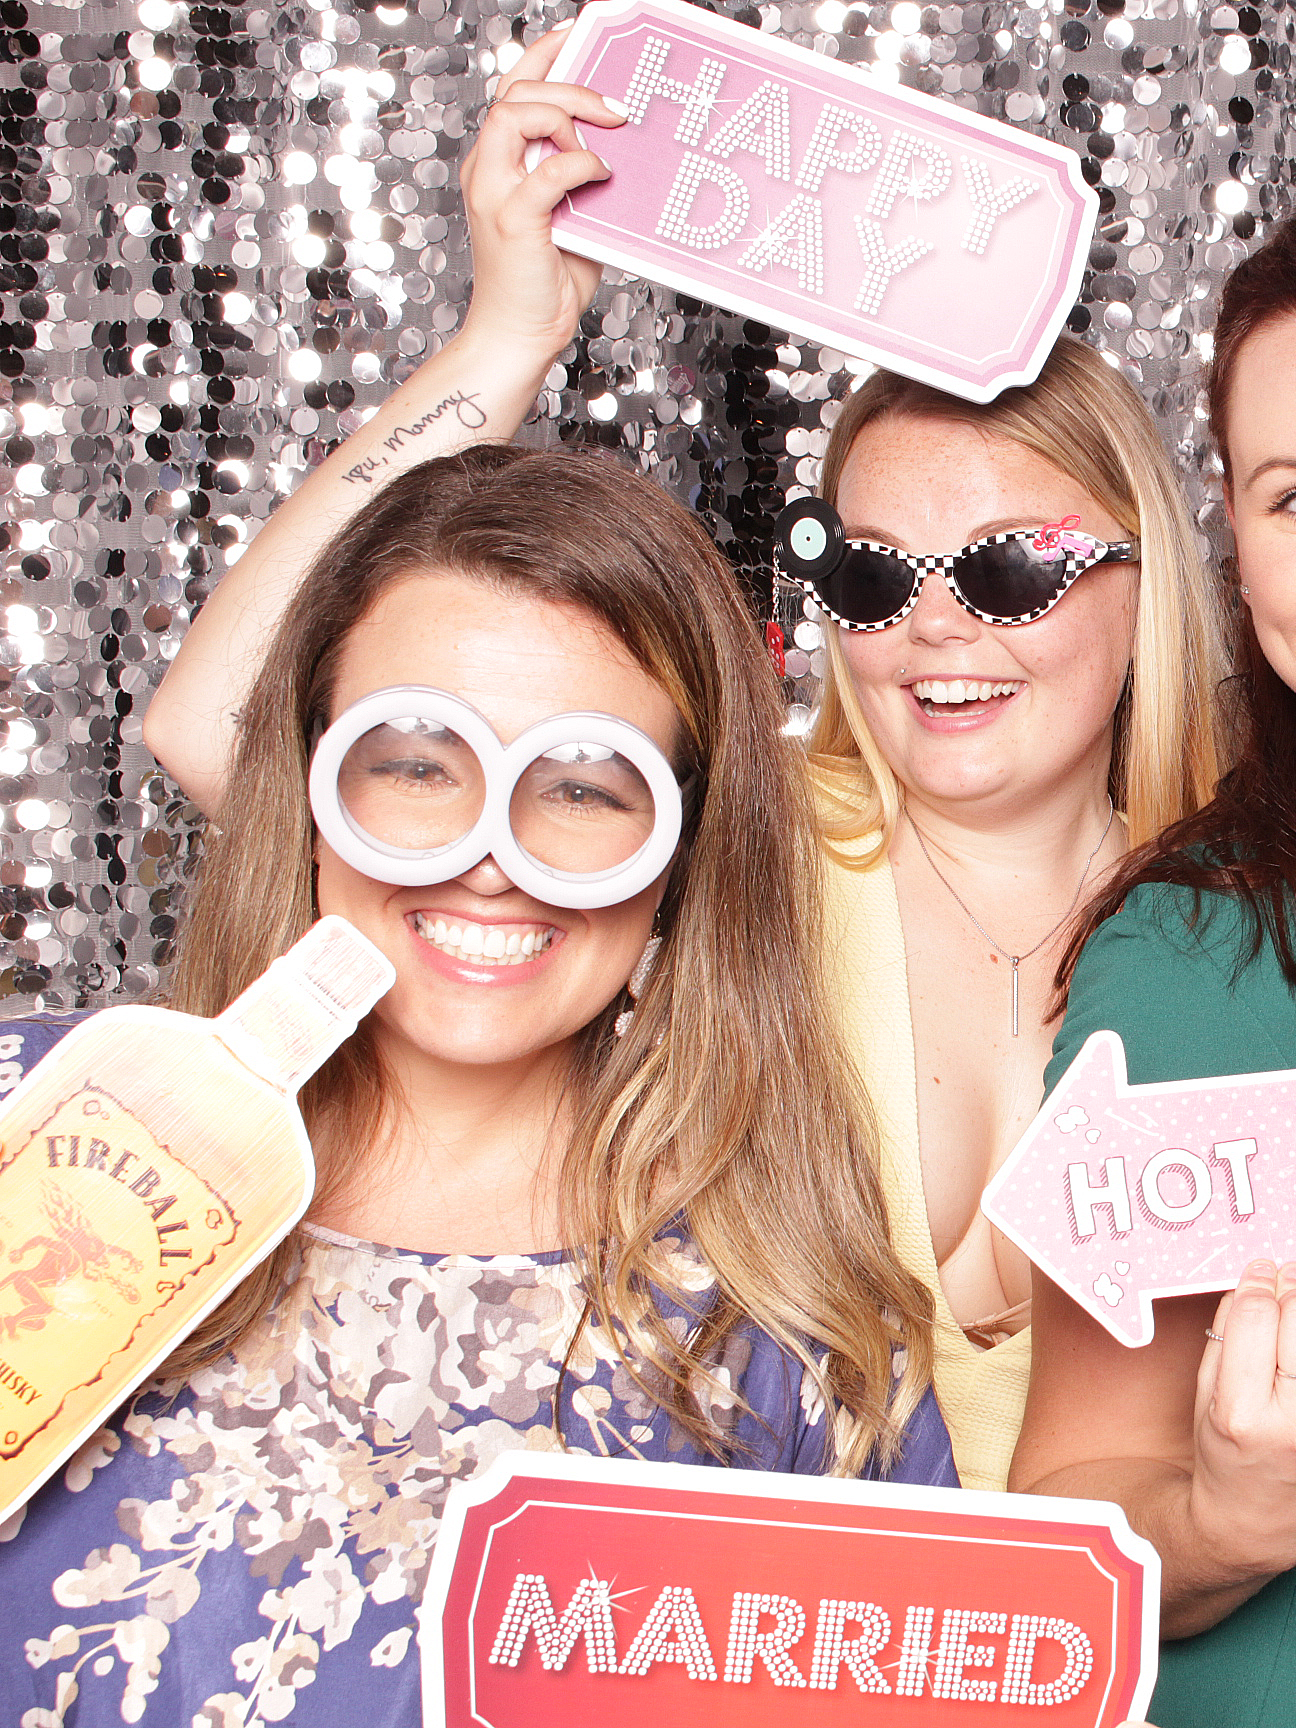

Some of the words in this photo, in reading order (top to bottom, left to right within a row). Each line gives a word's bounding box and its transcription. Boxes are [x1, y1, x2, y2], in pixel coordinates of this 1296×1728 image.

[622, 35, 1040, 255] HAPPY
[655, 151, 934, 315] DAY
[46, 1135, 192, 1267] FIREBALL
[1063, 1138, 1259, 1245] HOT
[487, 1572, 1095, 1706] MARRIED
